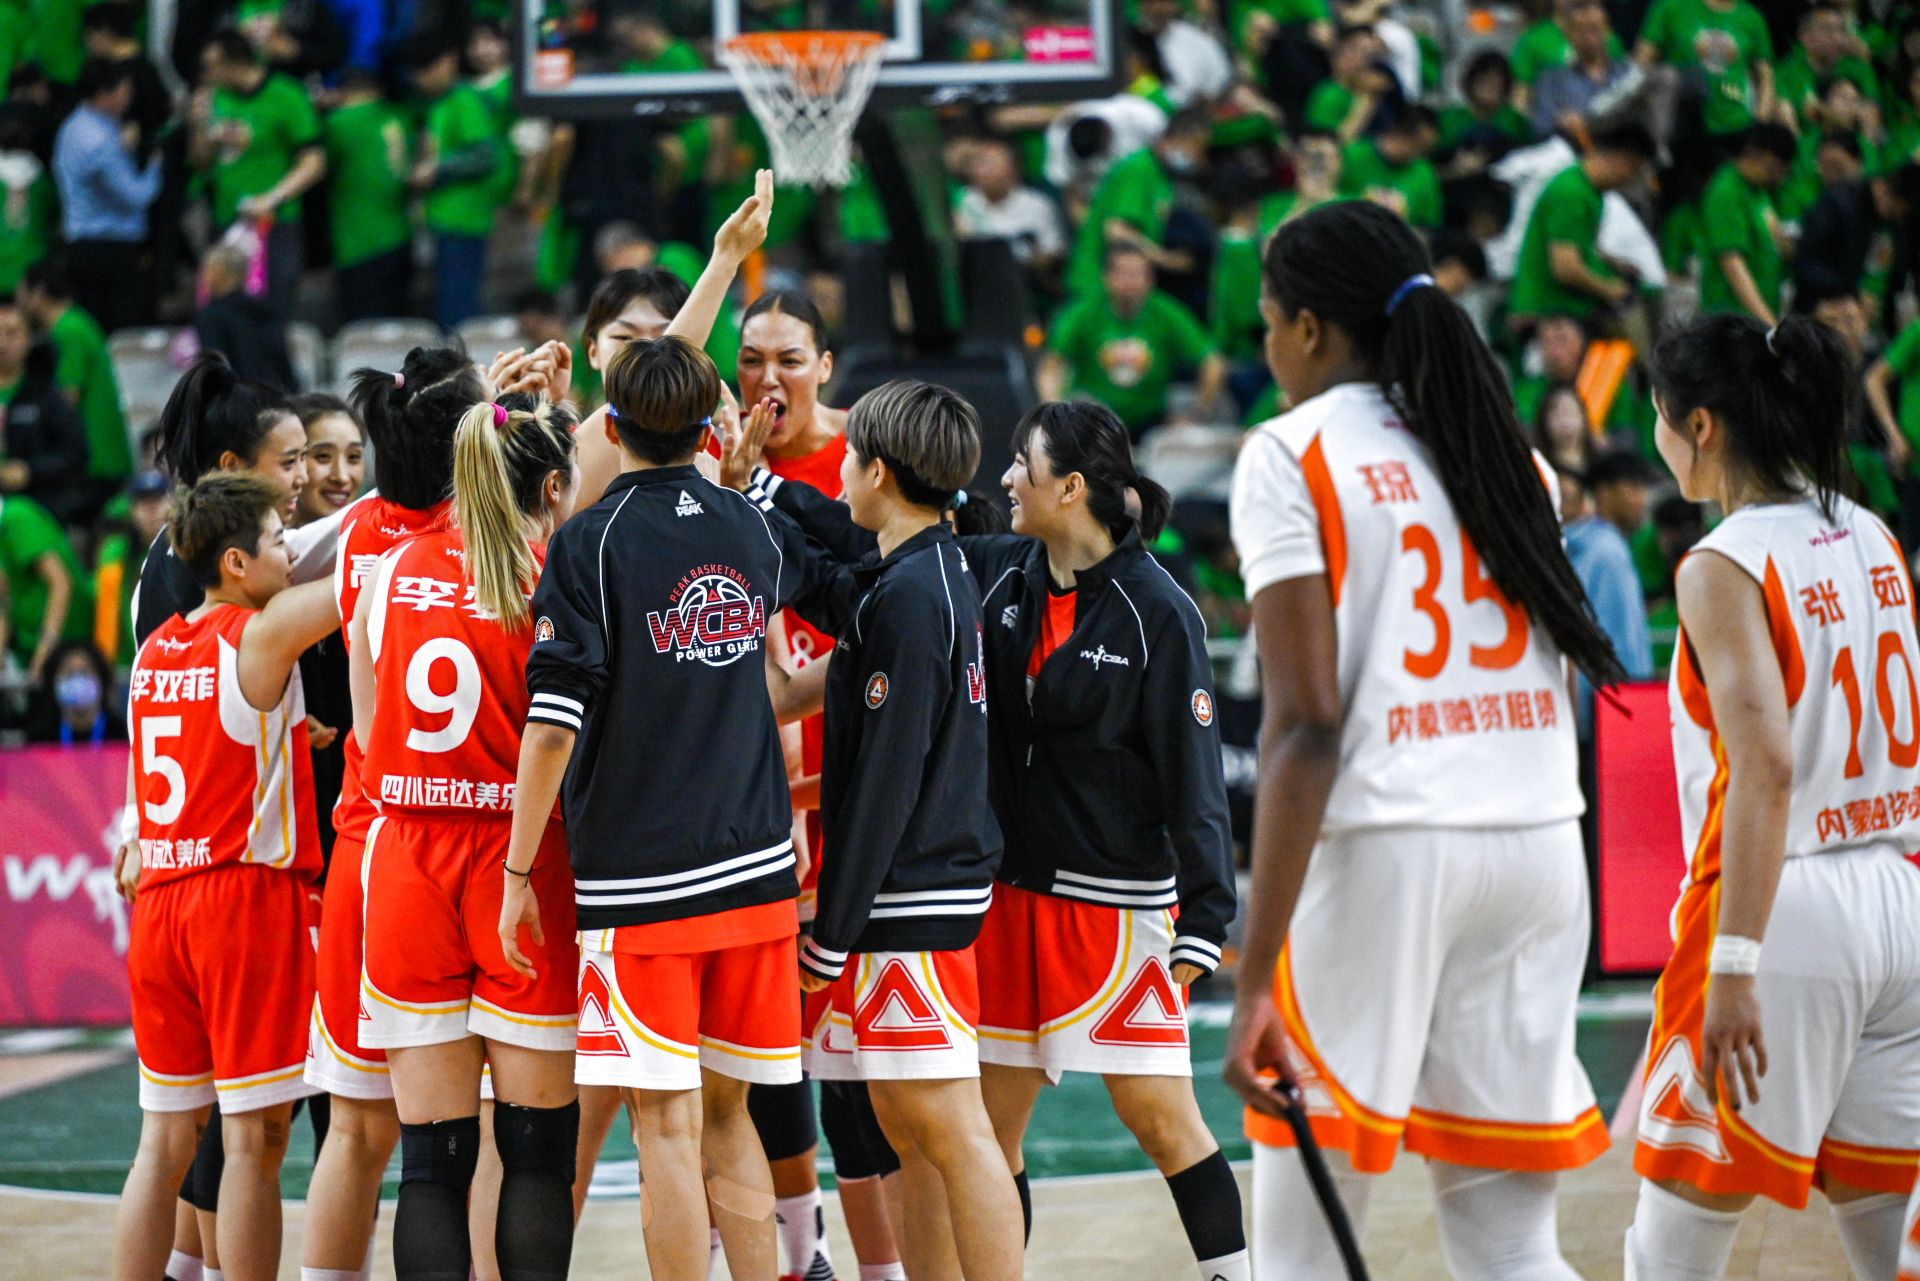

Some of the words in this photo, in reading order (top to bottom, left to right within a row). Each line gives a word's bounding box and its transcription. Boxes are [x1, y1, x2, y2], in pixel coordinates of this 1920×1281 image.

[674, 503, 705, 518] PEAK
[669, 574, 690, 603] PEAK
[690, 563, 751, 592] BASKETBALL
[1401, 522, 1529, 681] 35
[646, 595, 766, 654] WCBA
[675, 647, 722, 662] POWER
[726, 639, 758, 654] GIRLS
[132, 666, 216, 703] 李双菲
[405, 637, 482, 753] 9
[1832, 630, 1920, 780] 10
[141, 715, 186, 826] 5
[381, 774, 517, 812] 四川远达美乐
